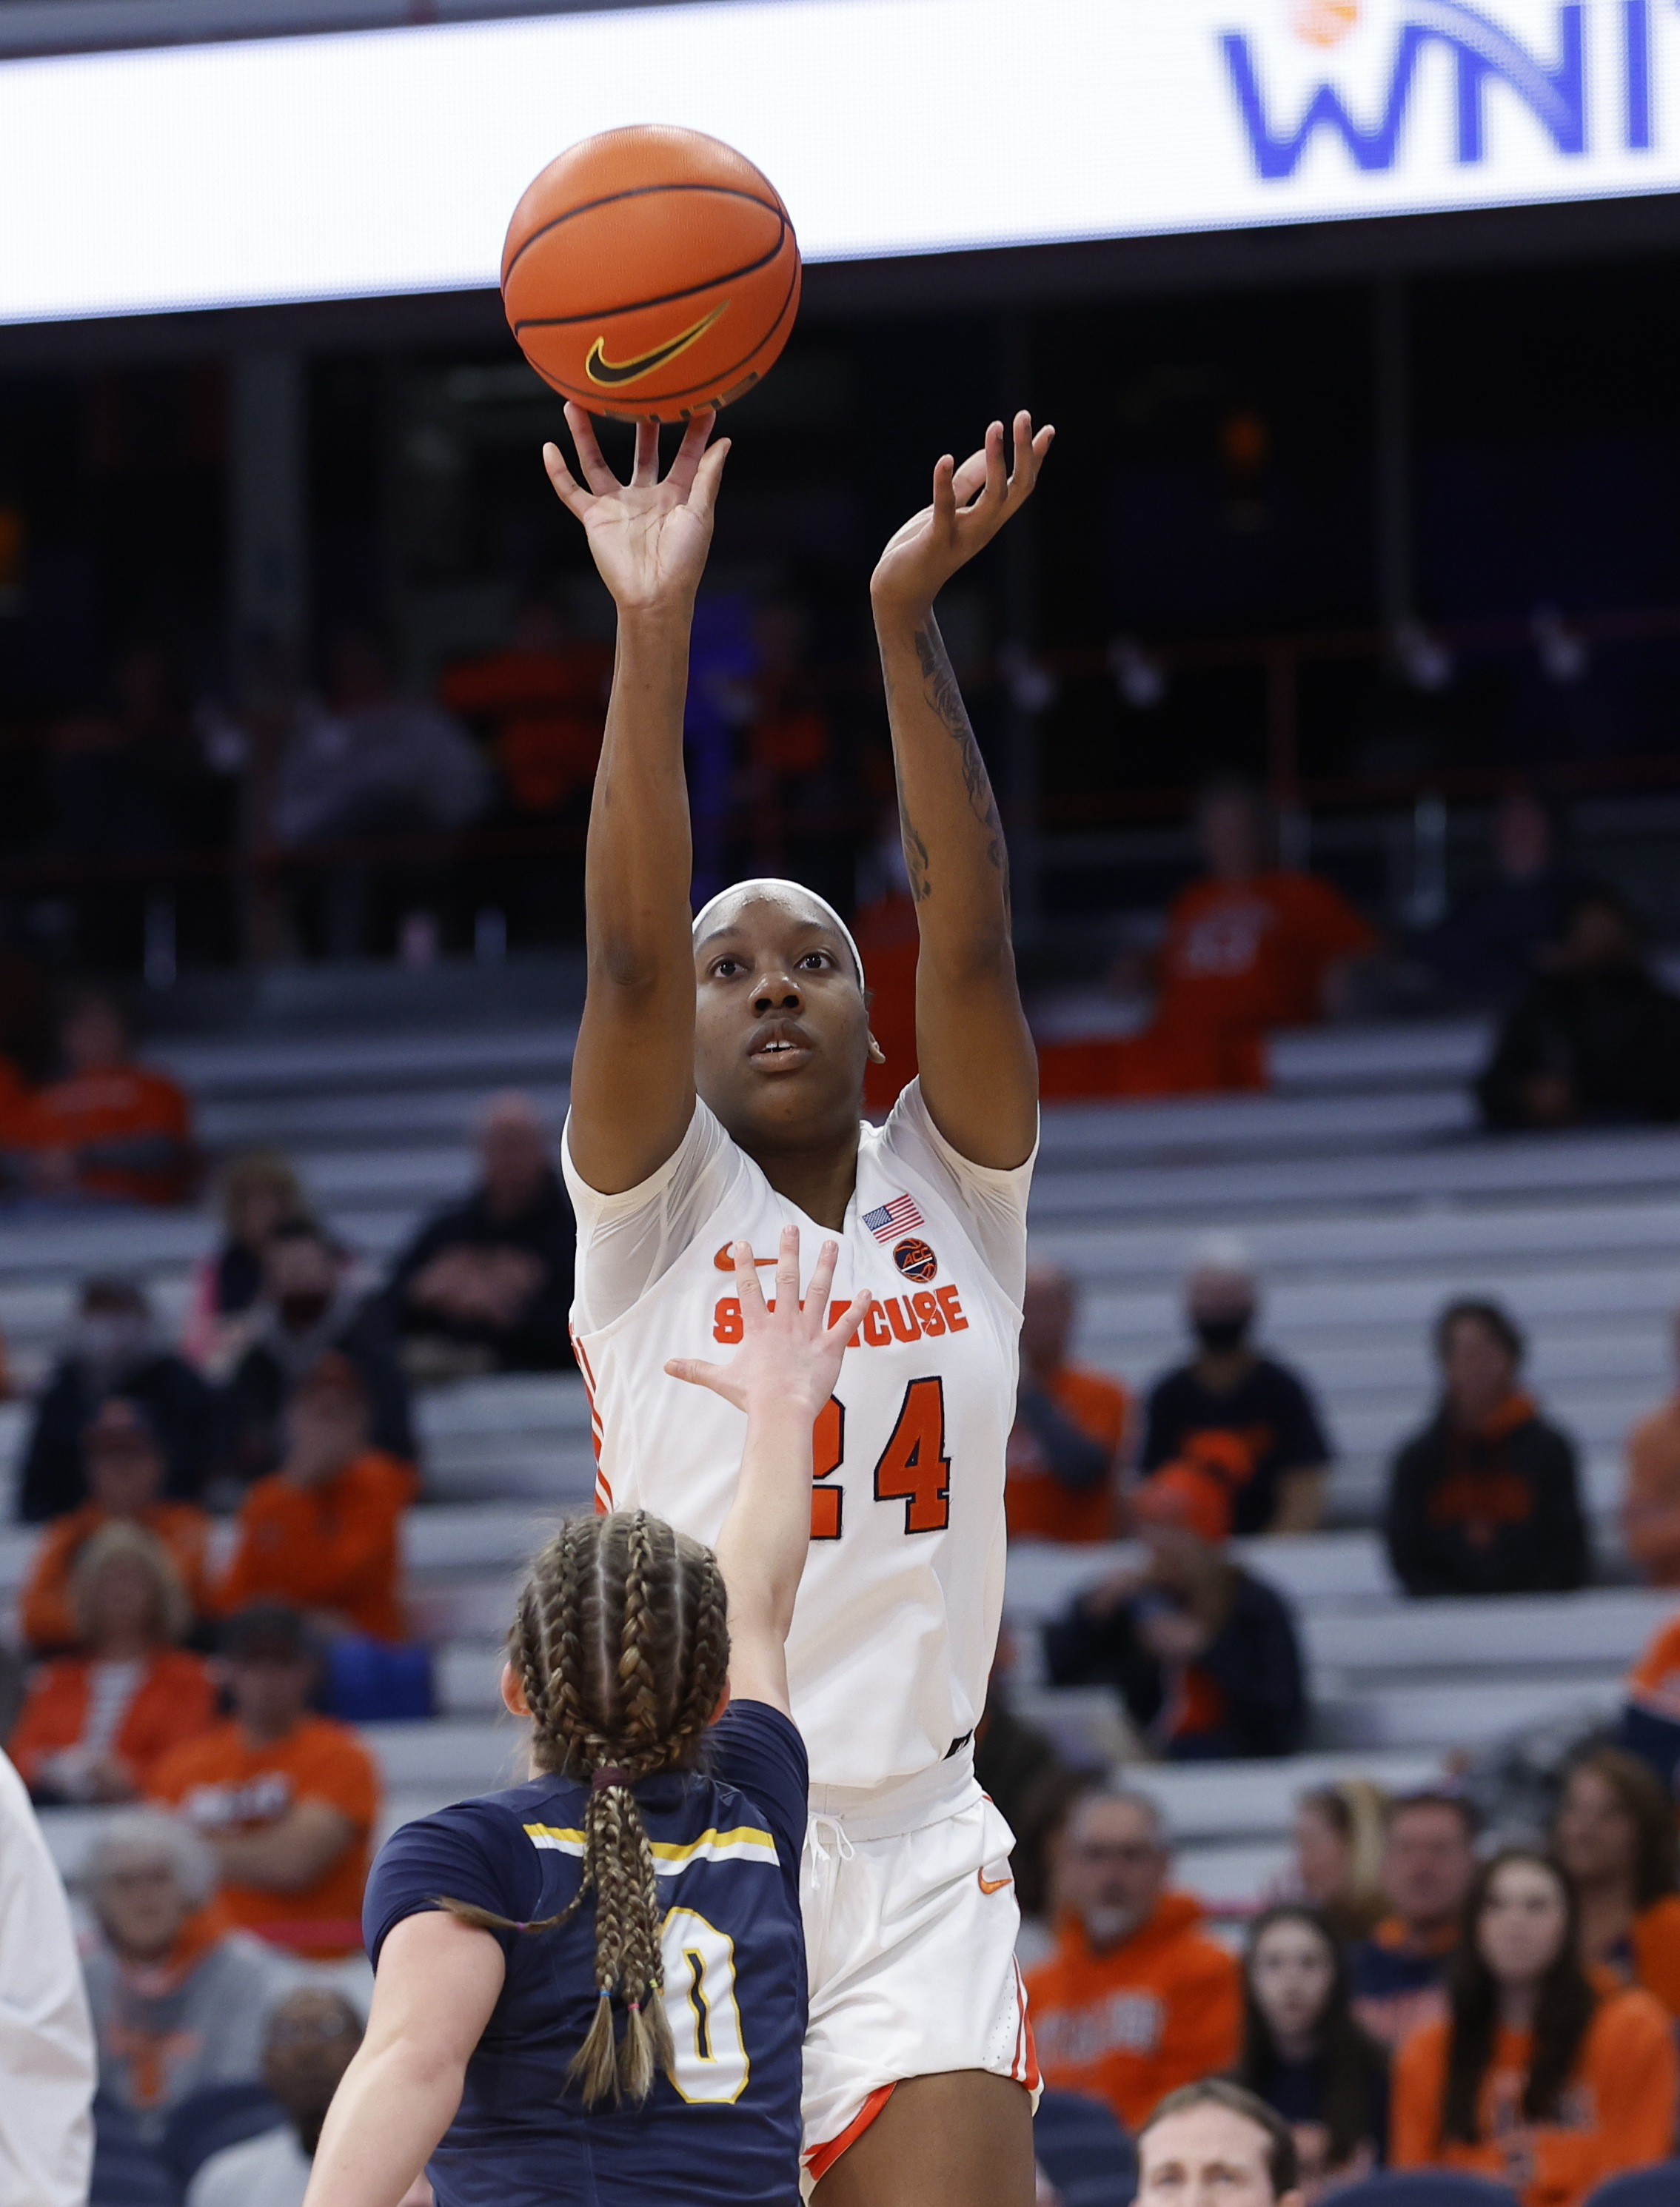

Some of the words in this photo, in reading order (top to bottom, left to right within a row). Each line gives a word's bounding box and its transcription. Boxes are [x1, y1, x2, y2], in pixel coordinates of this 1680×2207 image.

[1220, 0, 1680, 178] WNI
[903, 1247, 932, 1267] ACC
[713, 1285, 969, 1347] SCUSE
